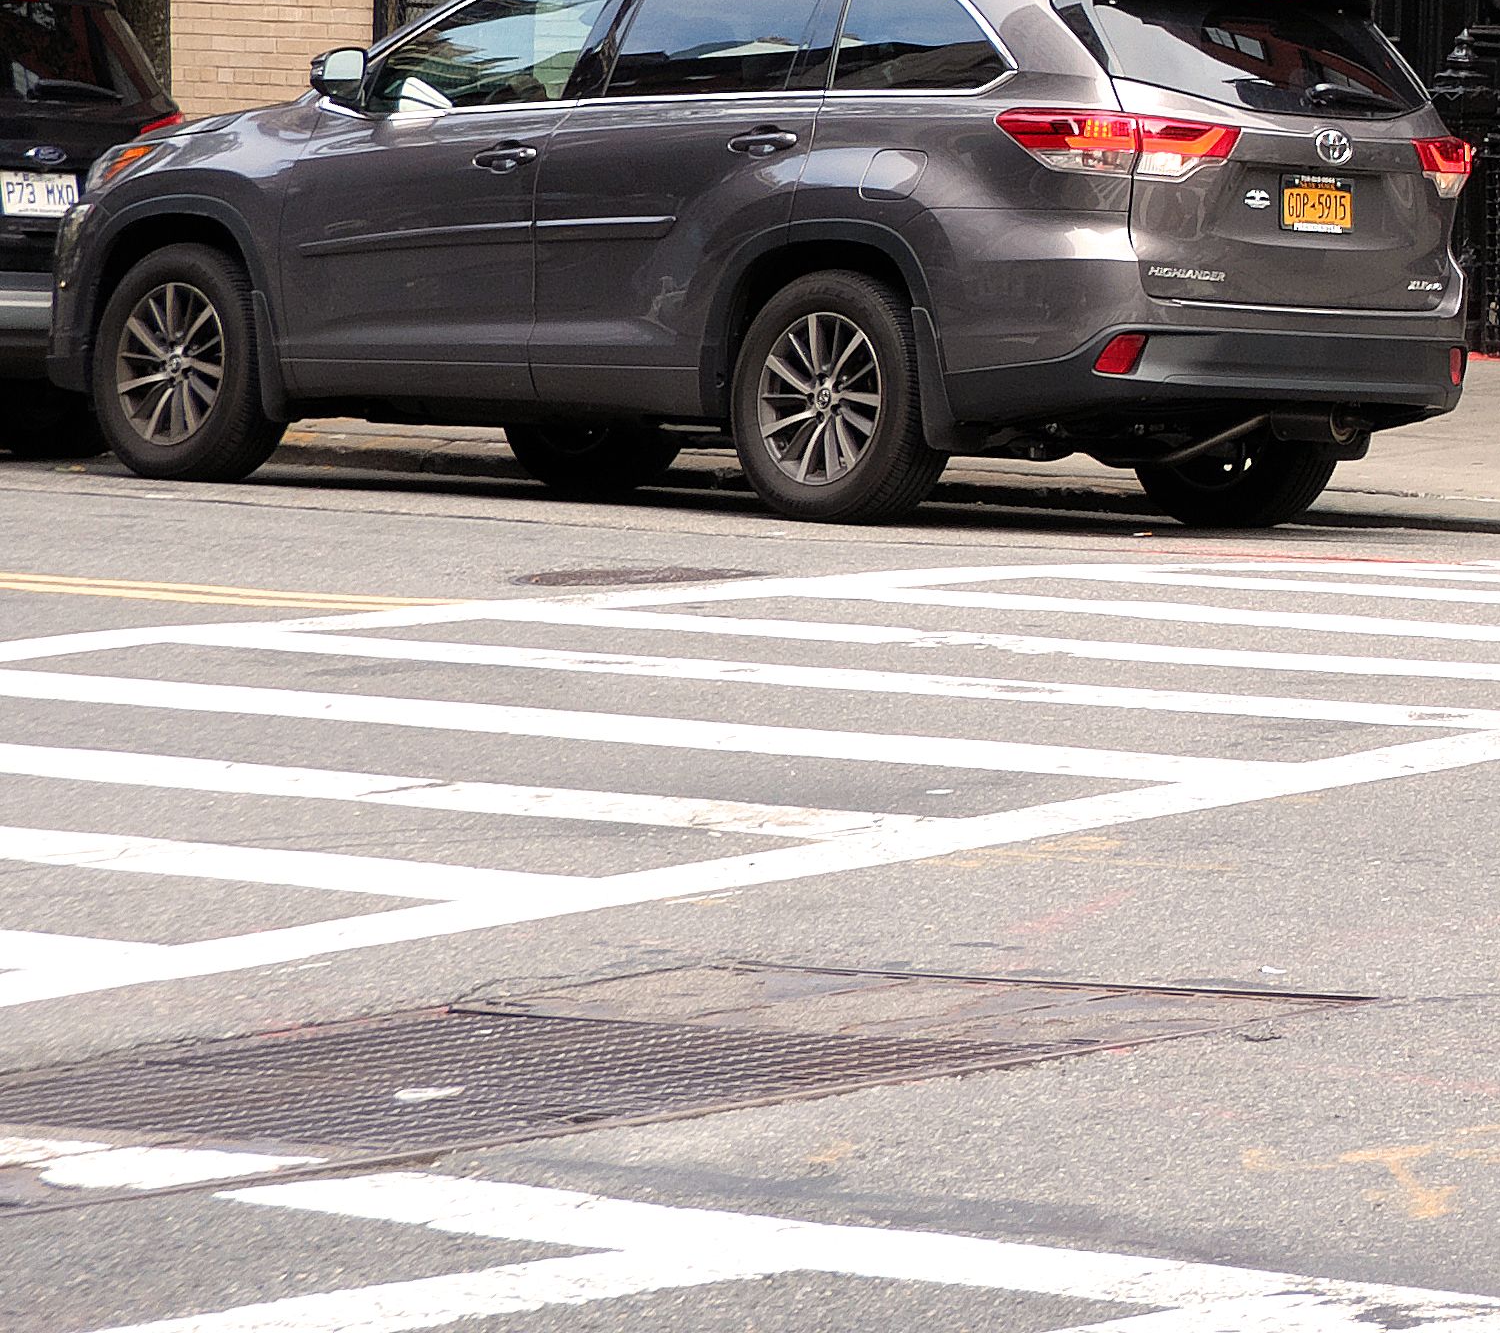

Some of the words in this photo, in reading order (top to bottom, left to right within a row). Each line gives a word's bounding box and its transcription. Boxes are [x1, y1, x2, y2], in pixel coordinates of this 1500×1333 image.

[6, 181, 36, 204] P73
[1288, 193, 1309, 218] GDP
[1318, 193, 1346, 220] 5915
[1148, 266, 1226, 282] HIGHLANDER
